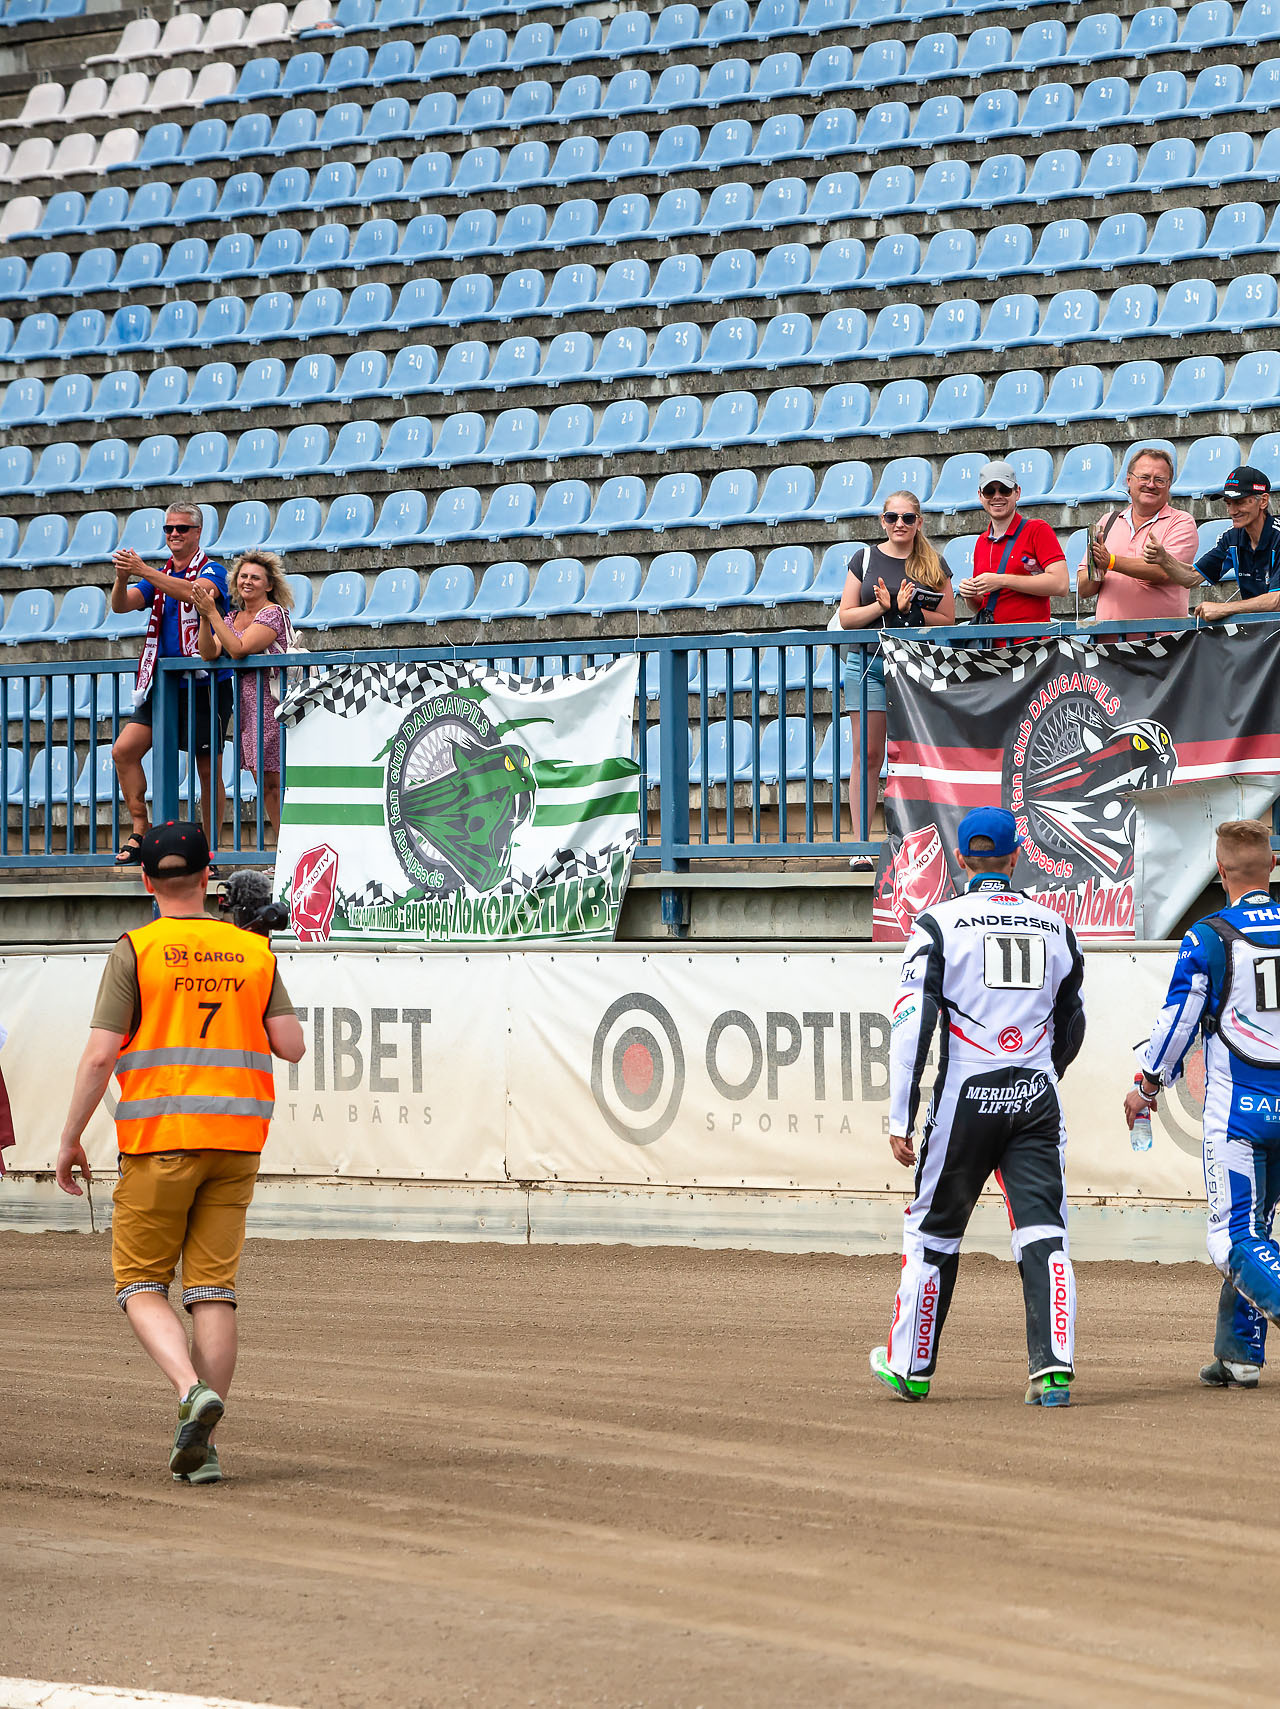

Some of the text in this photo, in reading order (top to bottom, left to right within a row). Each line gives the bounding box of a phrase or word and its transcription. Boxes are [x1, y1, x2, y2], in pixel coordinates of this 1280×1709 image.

[1214, 74, 1227, 87] 29
[1044, 91, 1059, 105] 26
[1099, 86, 1113, 99] 27
[987, 98, 1001, 110] 25
[825, 116, 839, 130] 22
[879, 111, 892, 124] 23
[330, 170, 340, 183] 12
[237, 181, 248, 193] 10
[1114, 223, 1126, 236] 31
[277, 239, 288, 249] 13
[892, 242, 904, 256] 27
[729, 256, 741, 270] 24
[572, 271, 584, 283] 21
[1184, 288, 1200, 305] 34
[1245, 283, 1263, 300] 35
[220, 303, 230, 315] 14
[947, 308, 965, 323] 30
[1005, 303, 1020, 321] 31
[1063, 300, 1082, 320] 32
[1124, 297, 1141, 319] 33
[781, 322, 795, 336] 27
[891, 312, 910, 332] 29
[675, 329, 689, 347] 25
[728, 326, 743, 341] 26
[513, 345, 526, 359] 22
[361, 360, 374, 376] 19
[408, 353, 423, 370] 20
[309, 360, 319, 380] 18
[212, 372, 223, 385] 16
[295, 508, 305, 522] 22
[346, 507, 357, 521] 23
[1028, 671, 1121, 722] DAUGAVPILS
[1013, 717, 1033, 767] club
[389, 696, 490, 888] speedway fan club DAUGAVPILS
[1010, 772, 1024, 812] fan
[953, 915, 1061, 935] ANDERSEN
[194, 951, 245, 964] CARGO
[995, 937, 1031, 984] 11
[173, 977, 246, 993] FOTO/TV
[198, 1002, 223, 1039] 7
[705, 1009, 891, 1102] OPTIB
[965, 1082, 1039, 1101] MERIDIAN
[347, 1099, 433, 1126] BĀRS
[978, 1099, 1023, 1114] LIFTS
[705, 1111, 852, 1135] SPORTA
[1205, 1140, 1221, 1223] SAGARI
[1053, 1262, 1070, 1345] daytona
[916, 1281, 939, 1359] daytona
